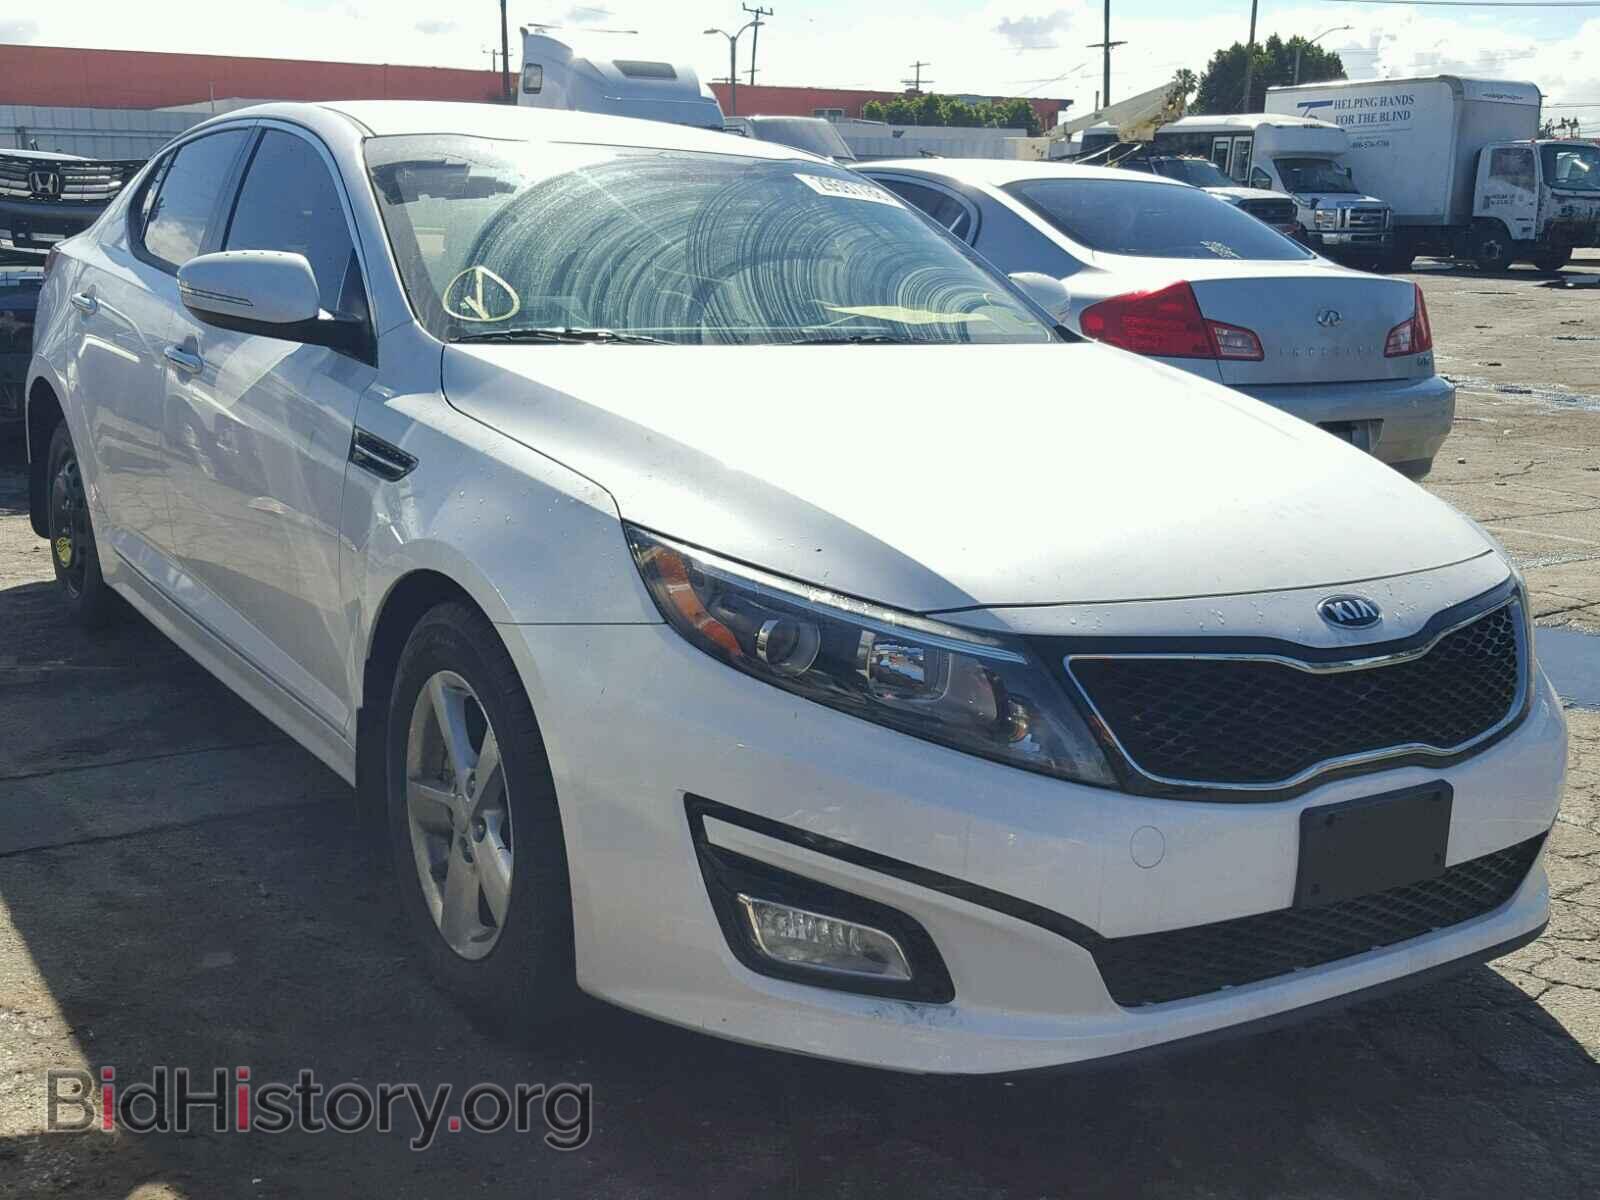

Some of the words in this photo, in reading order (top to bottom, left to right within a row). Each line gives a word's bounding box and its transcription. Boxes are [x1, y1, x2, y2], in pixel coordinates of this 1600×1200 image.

[1334, 97, 1377, 110] HELPING
[1380, 94, 1415, 107] HANDS
[1336, 114, 1354, 125] FOR
[1358, 112, 1377, 124] THE
[1379, 110, 1411, 122] BLIND
